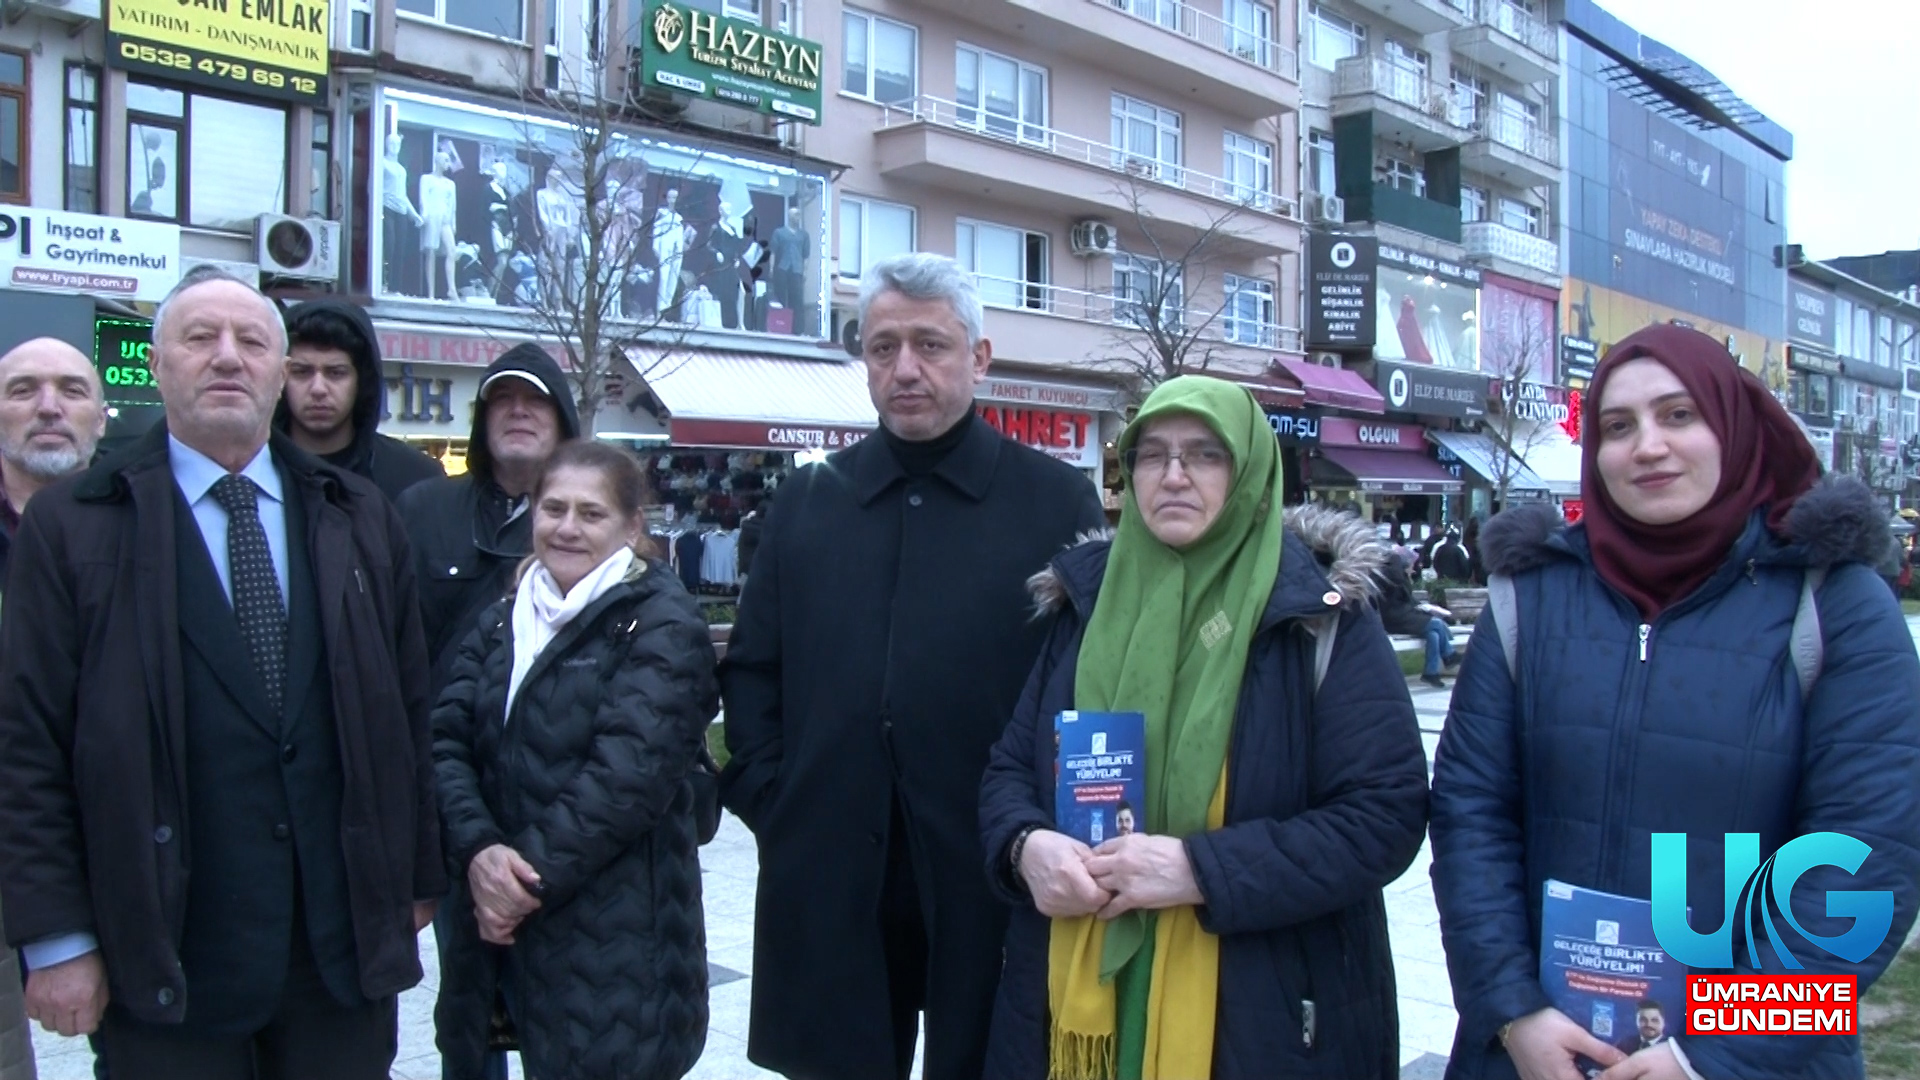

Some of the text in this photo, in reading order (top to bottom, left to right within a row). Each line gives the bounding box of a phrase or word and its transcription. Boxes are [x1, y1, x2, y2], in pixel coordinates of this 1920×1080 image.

[241, 0, 323, 35] EMLAK
[117, 5, 189, 33] YATIRIM
[207, 25, 320, 61] DANIŞMANLIK
[690, 9, 820, 77] HAZEYN
[121, 42, 316, 94] 0532 479 69 12
[47, 217, 121, 243] İnşaat &
[46, 244, 166, 269] Gayrimenkul
[16, 269, 134, 290] www.tryapi.com.tr
[106, 366, 158, 387] 053
[991, 384, 1088, 405] FAHRET KUYUMCU
[828, 430, 839, 446] &
[1359, 424, 1399, 444] OLGUN
[1553, 940, 1664, 963] GELECEĞE BİRLİKTE
[1569, 954, 1645, 973] YÜRÜYELİM!
